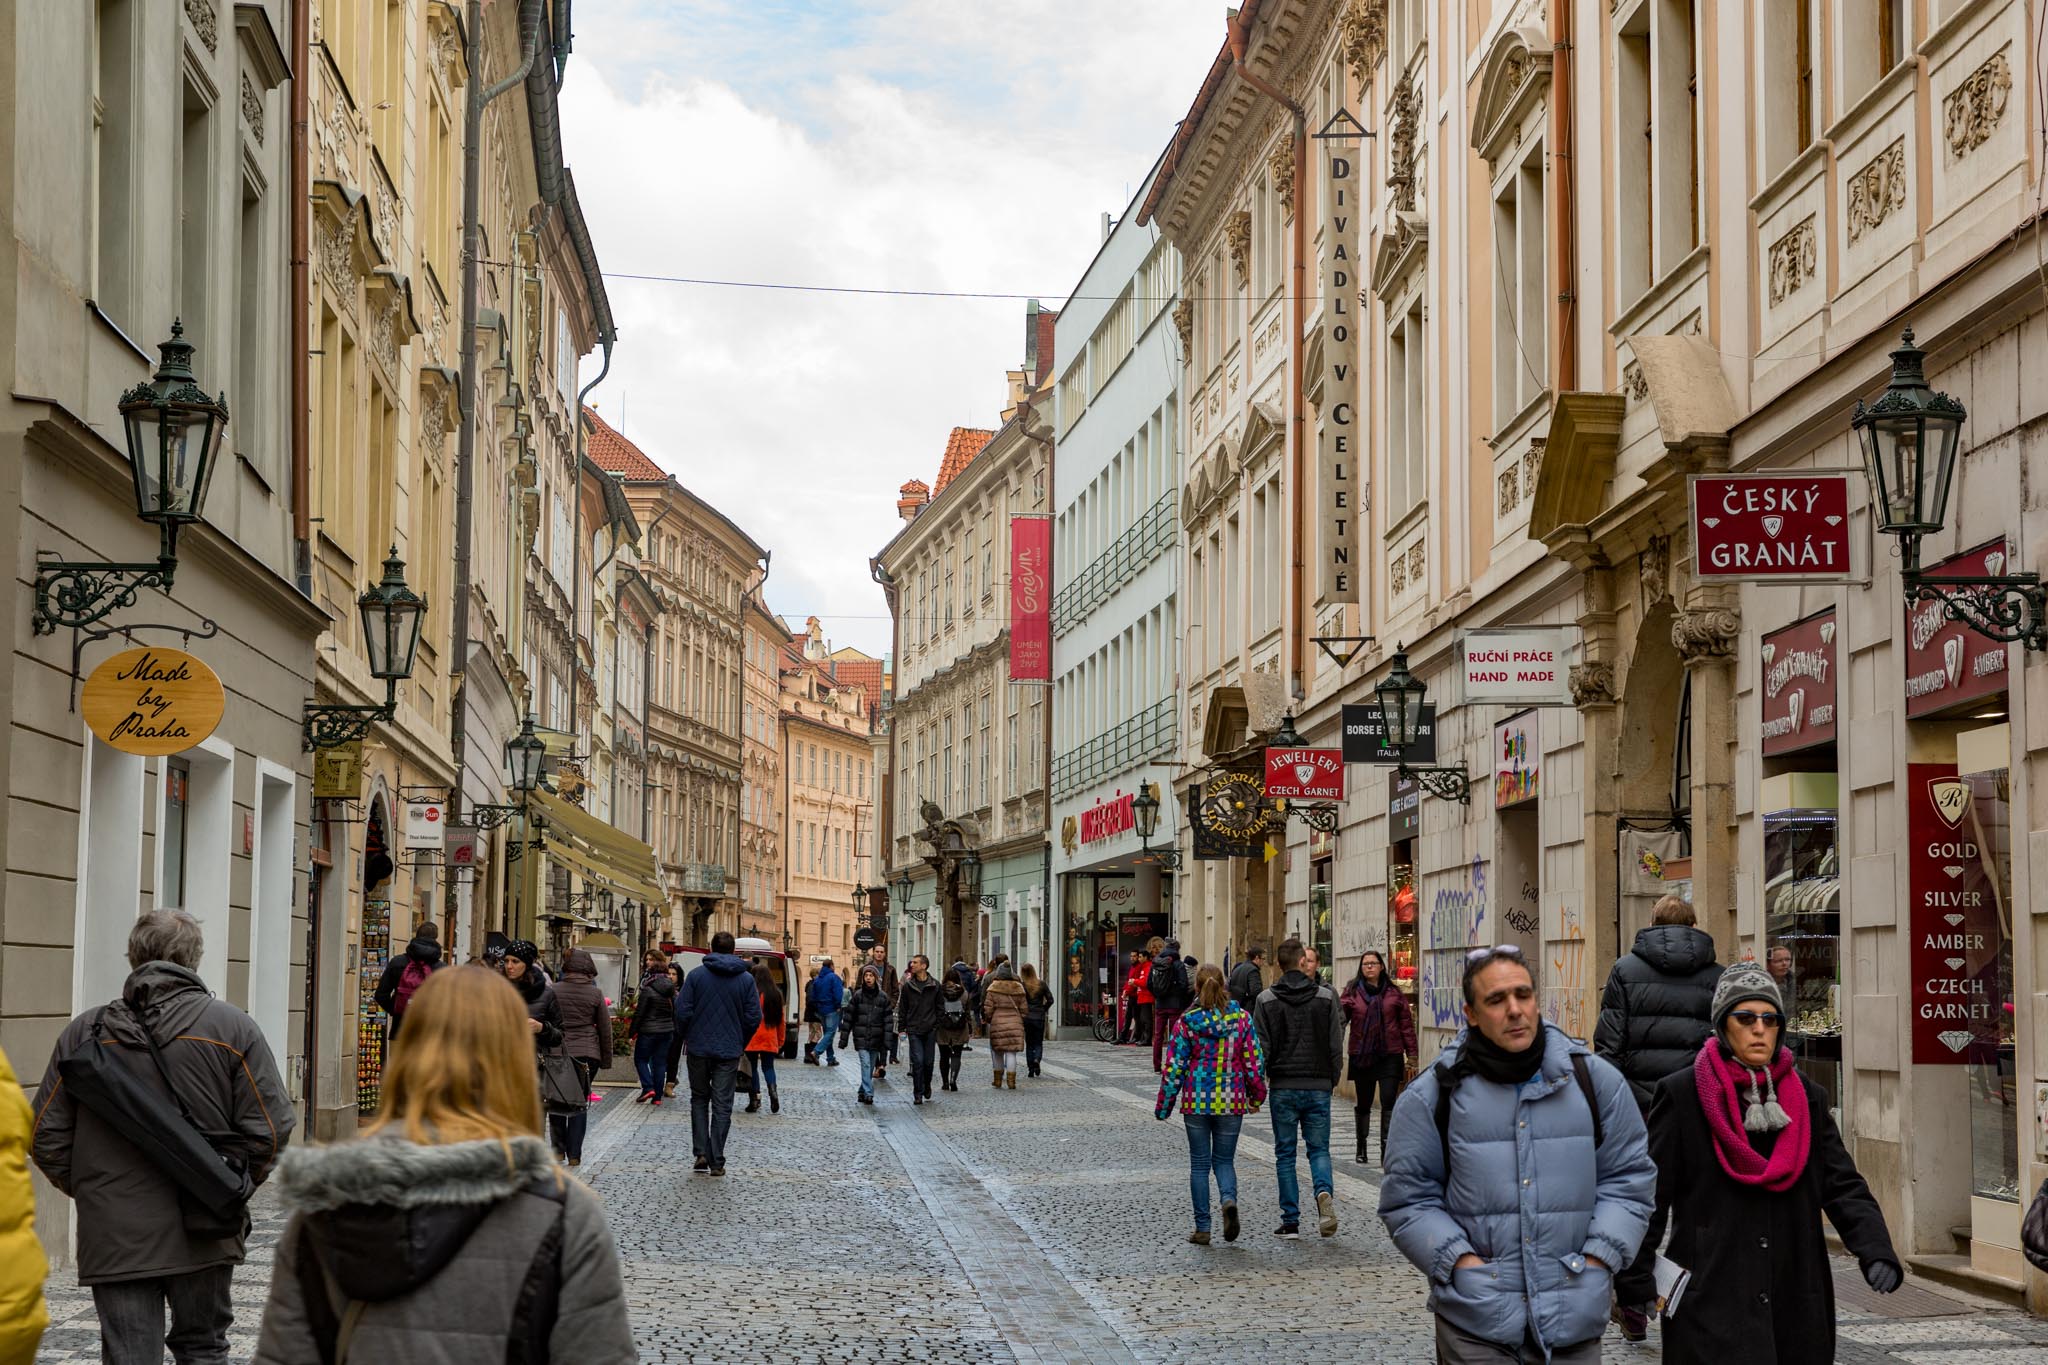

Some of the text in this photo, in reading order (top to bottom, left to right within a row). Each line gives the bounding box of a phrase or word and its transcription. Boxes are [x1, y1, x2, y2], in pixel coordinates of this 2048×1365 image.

[1332, 157, 1350, 592] DIVADLO V CELETNÉ
[1722, 484, 1820, 515] ČESKÝ
[1711, 535, 1837, 568] GRANÁT
[1469, 649, 1553, 662] RUČNÍ PRÁCE
[117, 652, 192, 682] Made
[1469, 671, 1554, 682] HAND MADE
[137, 687, 173, 719] by
[109, 711, 191, 741] Praha
[1346, 725, 1375, 735] BORSE
[1376, 725, 1382, 735] E
[1270, 751, 1339, 773] JEWELLERY
[1269, 786, 1339, 797] CZECH GARNET
[1927, 843, 1978, 858] GOLD
[1924, 891, 1982, 907] SILVER
[1924, 934, 1984, 949] AMBER
[1925, 979, 1984, 995] CZECH
[1920, 1003, 1990, 1019] GARNET
